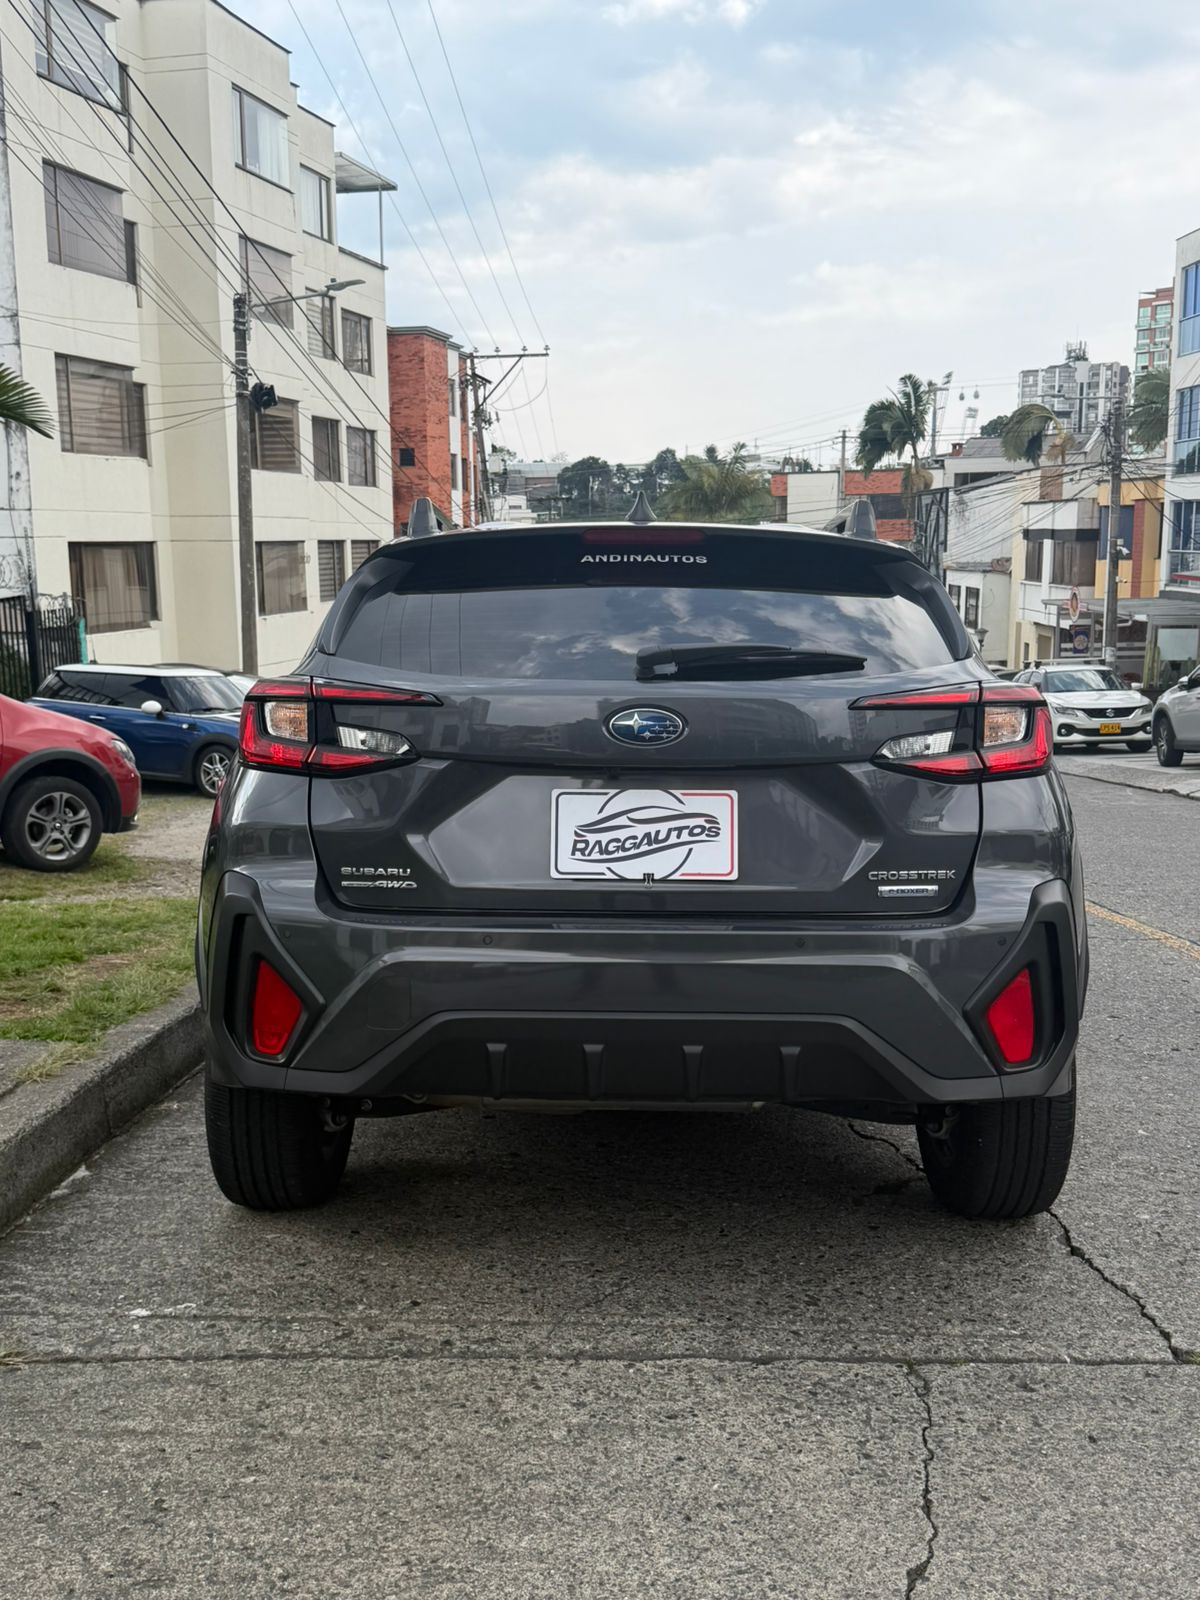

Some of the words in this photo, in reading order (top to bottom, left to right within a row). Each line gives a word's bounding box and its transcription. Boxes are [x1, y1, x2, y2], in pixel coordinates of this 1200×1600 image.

[580, 554, 708, 564] ANDINAUTOS
[570, 824, 721, 857] RAGGAUTOS
[340, 866, 411, 876] SUBARU
[868, 869, 956, 880] CROSSTREK
